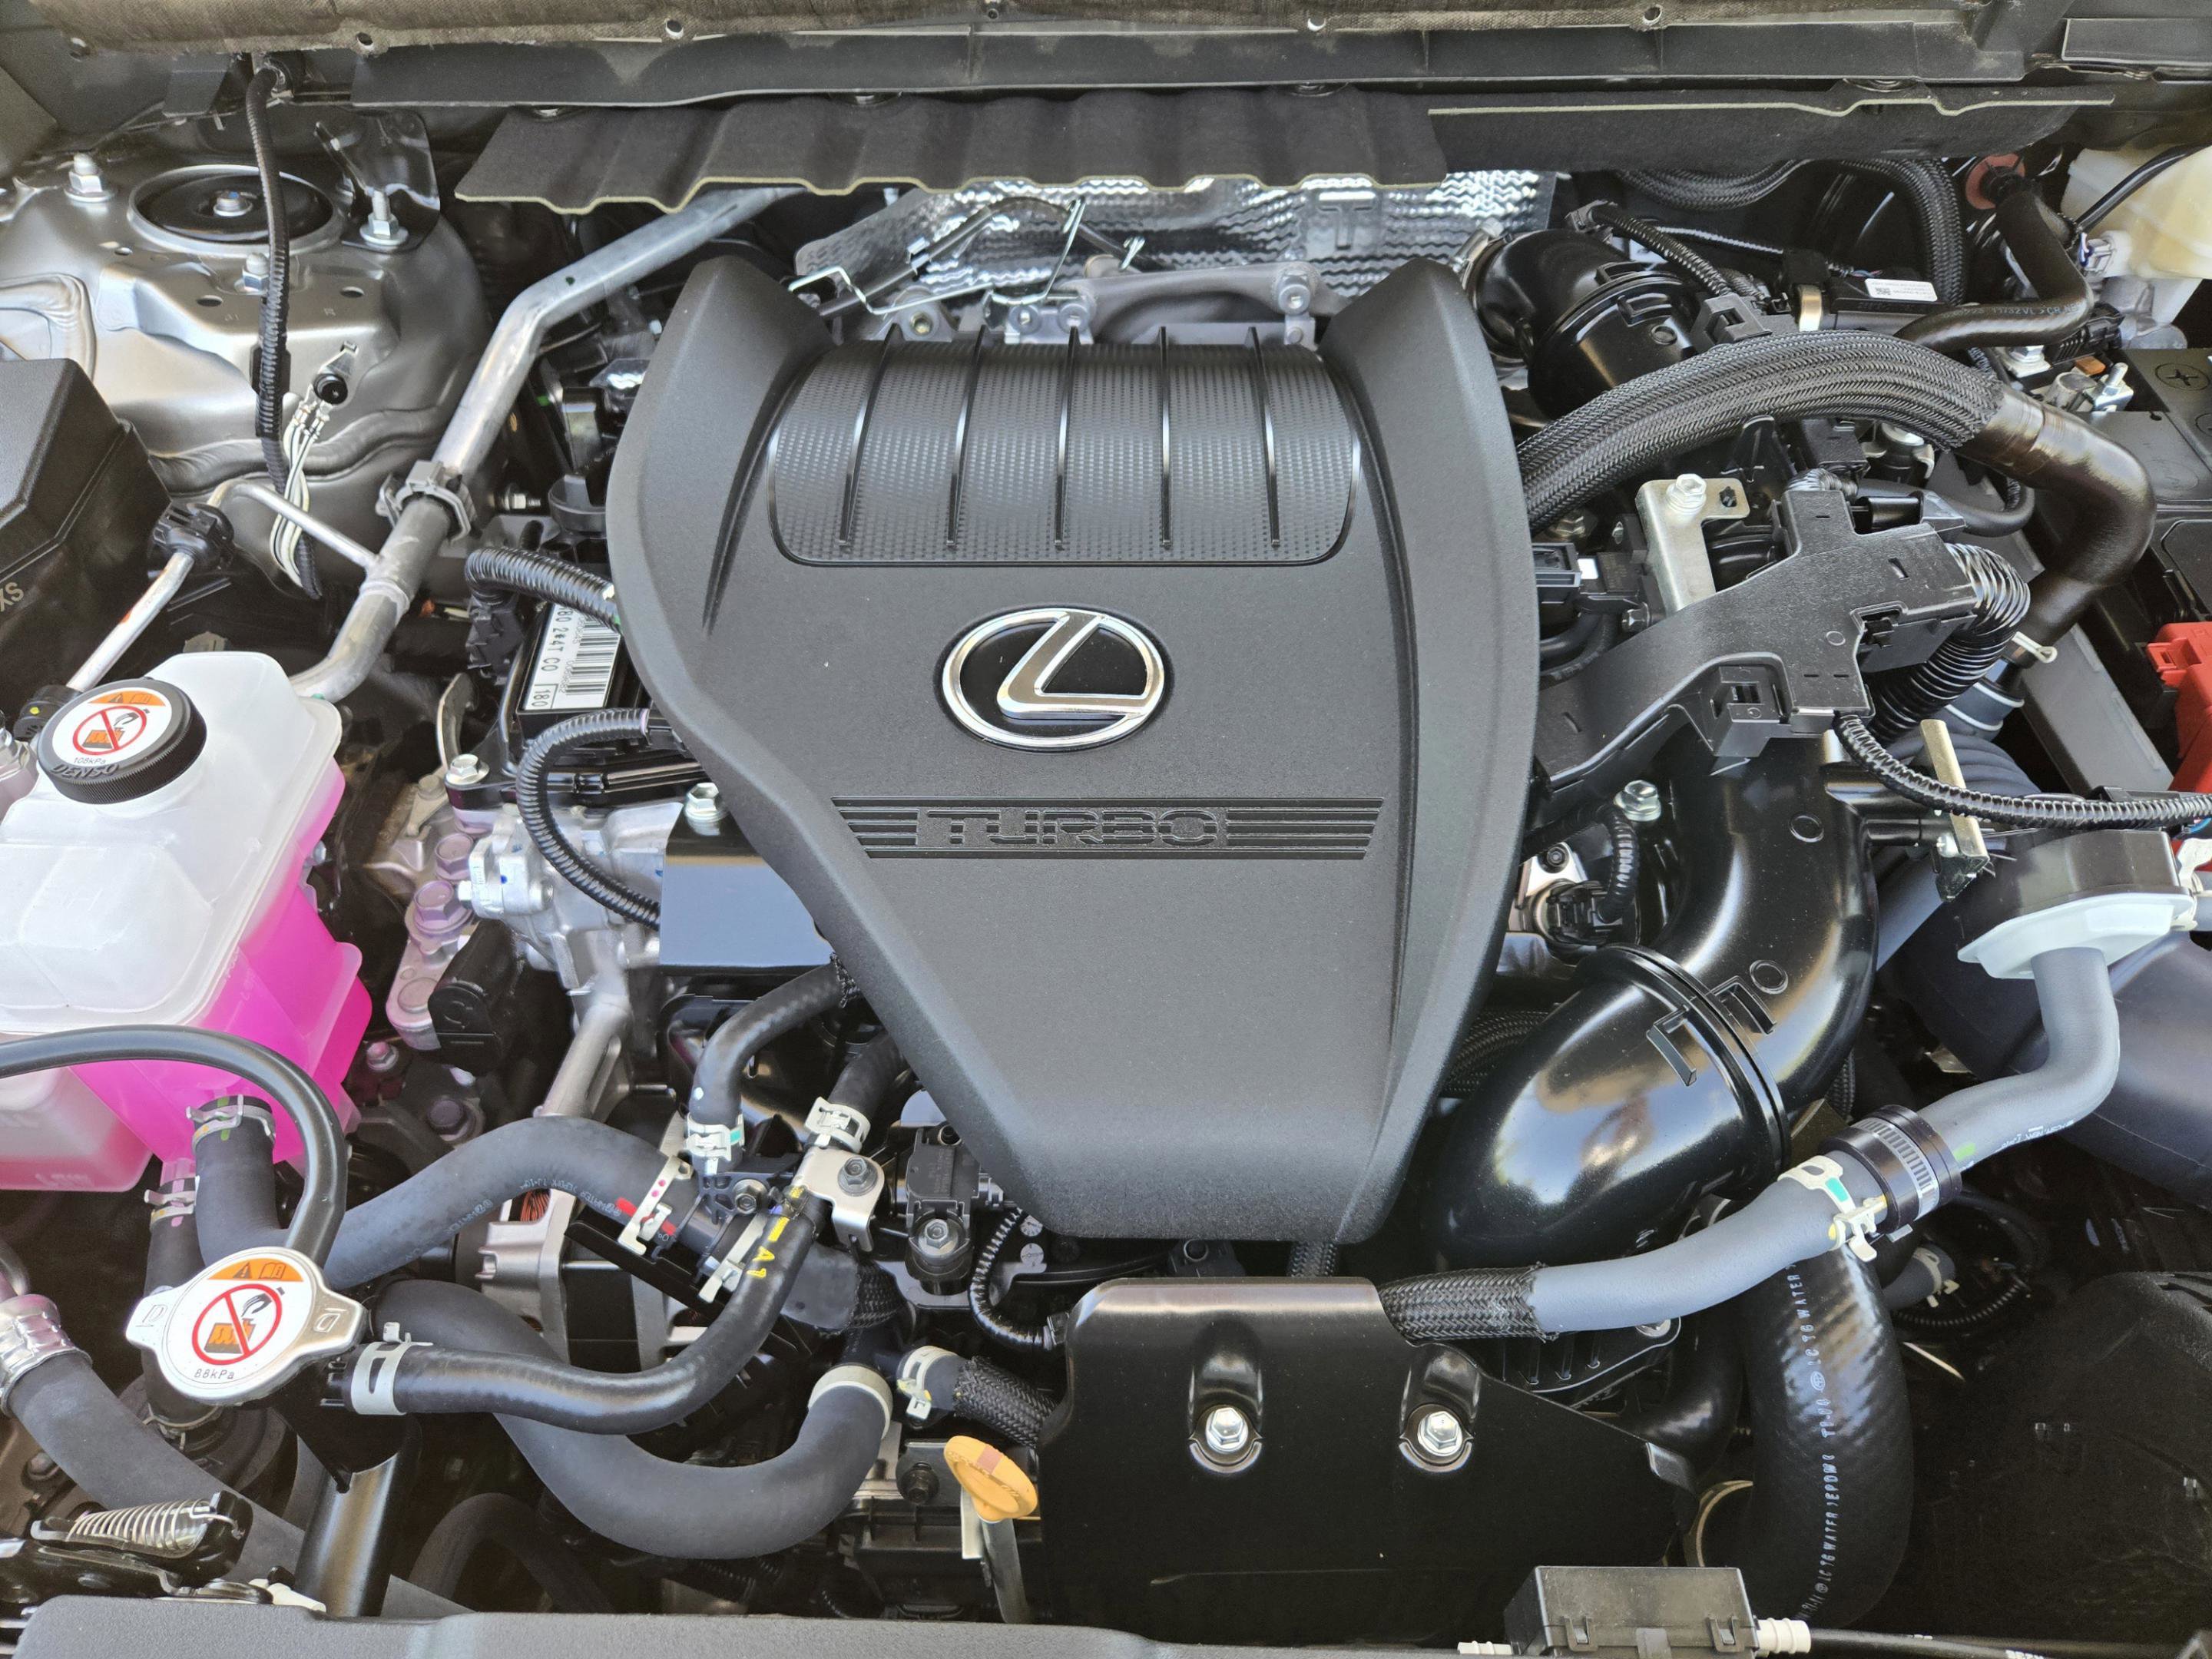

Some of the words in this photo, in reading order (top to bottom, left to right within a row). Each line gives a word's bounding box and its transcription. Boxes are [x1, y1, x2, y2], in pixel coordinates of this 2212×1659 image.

[531, 689, 550, 707] 180
[49, 763, 120, 779] DENSO
[926, 809, 1220, 846] TURBO
[1786, 1273, 1811, 1319] WATER
[194, 1367, 236, 1380] 88kPa
